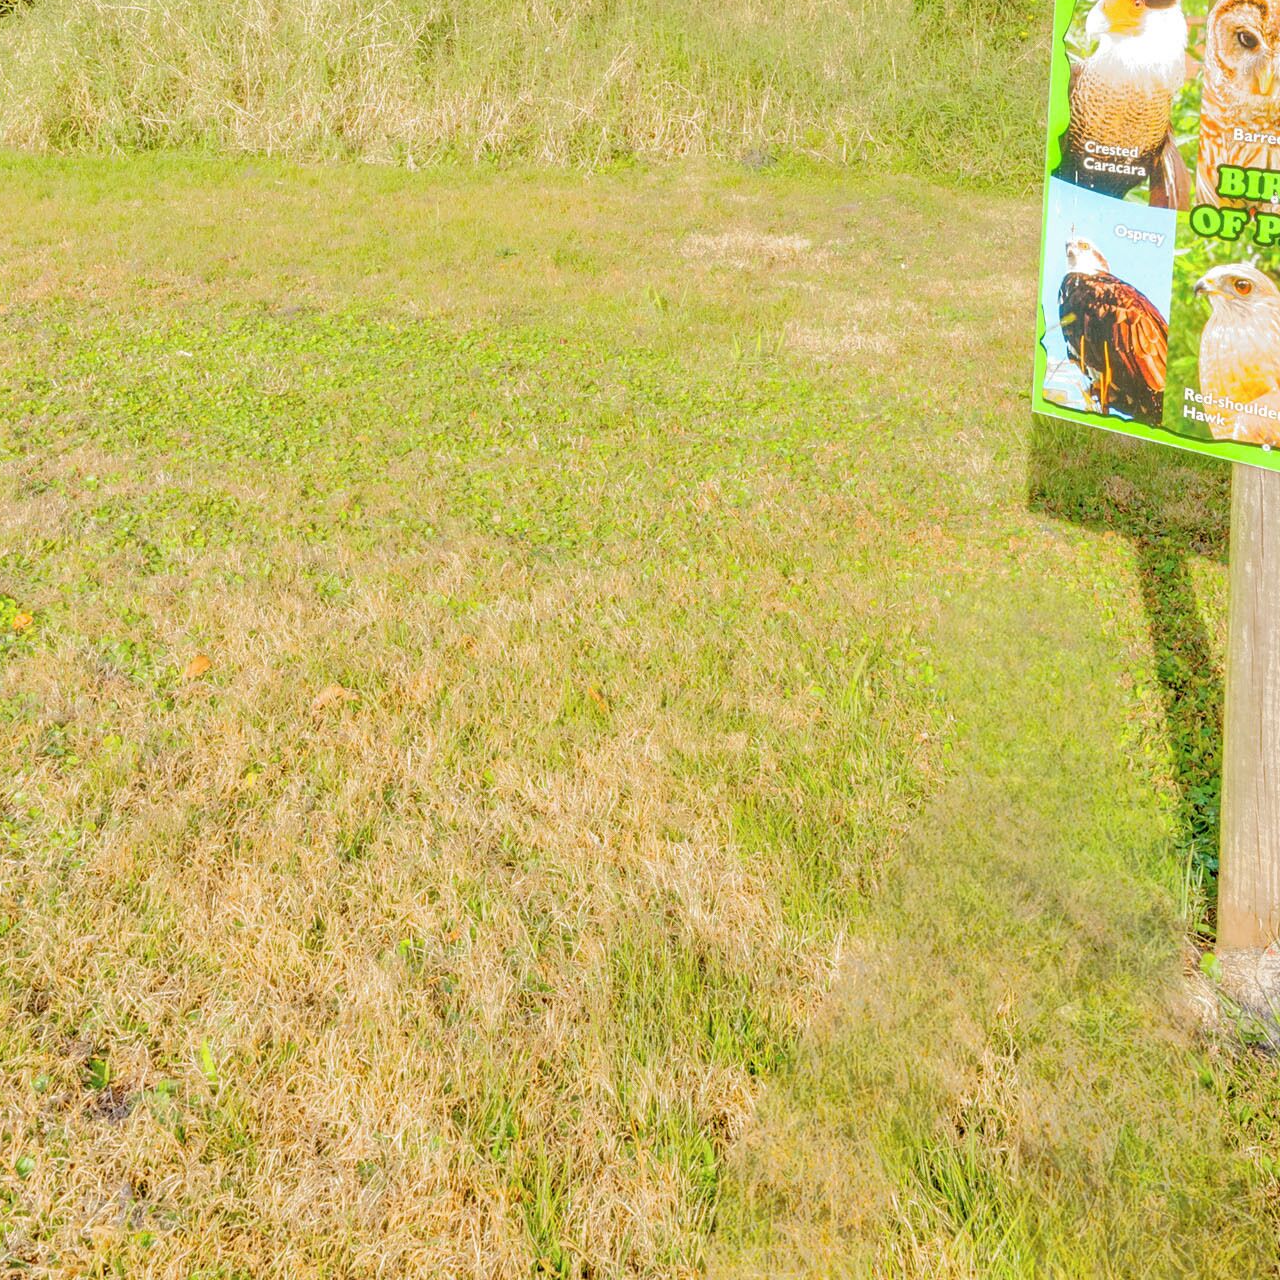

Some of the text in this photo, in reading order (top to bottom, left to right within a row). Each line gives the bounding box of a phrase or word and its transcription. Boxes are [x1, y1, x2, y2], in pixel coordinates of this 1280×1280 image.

[1084, 140, 1139, 158] Crested
[1083, 157, 1147, 177] Caracara
[1191, 206, 1248, 239] OF
[1114, 224, 1165, 247] Osprey
[1183, 405, 1226, 426] Hawk
